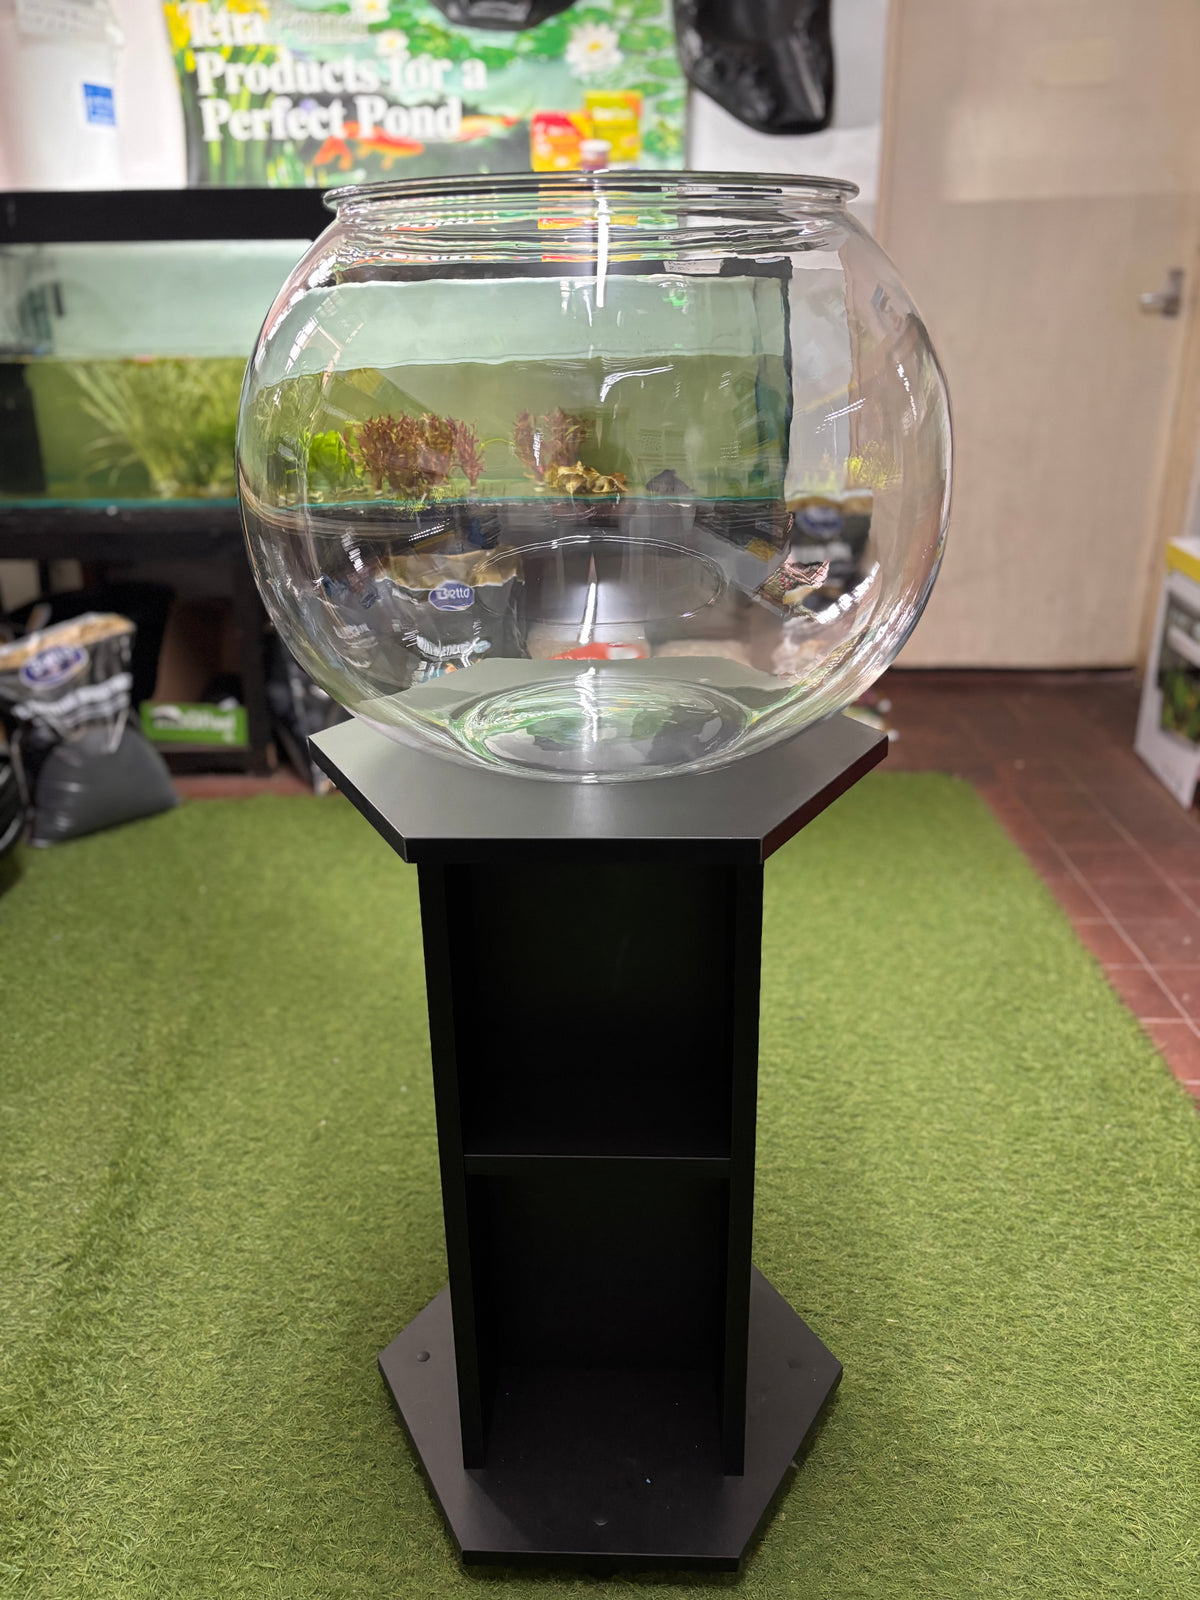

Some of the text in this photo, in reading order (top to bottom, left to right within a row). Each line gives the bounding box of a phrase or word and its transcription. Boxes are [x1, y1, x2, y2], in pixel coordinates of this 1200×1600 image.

[179, 3, 266, 47] Tetra
[195, 49, 487, 95] Products for a
[200, 94, 463, 141] Perfect Pond
